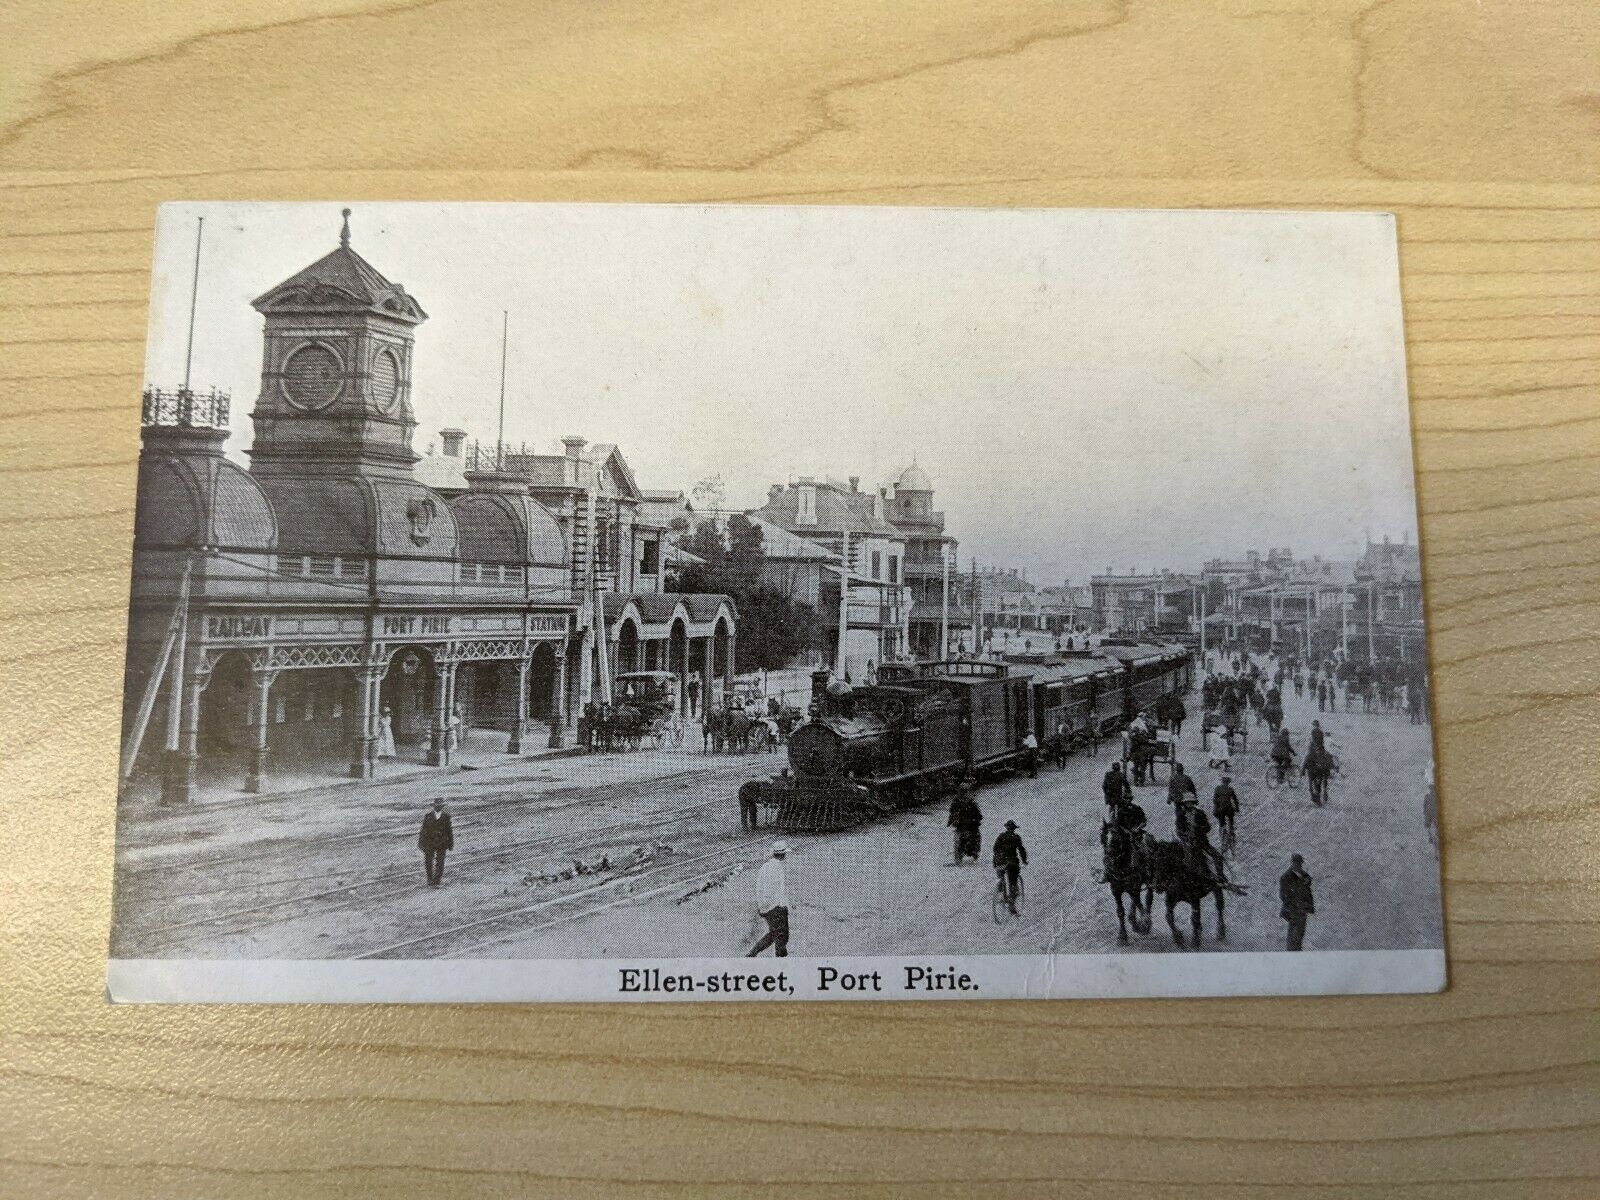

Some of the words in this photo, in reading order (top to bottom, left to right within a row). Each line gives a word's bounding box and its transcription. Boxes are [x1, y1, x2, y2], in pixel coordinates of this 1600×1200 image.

[383, 616, 415, 635] PORT
[530, 615, 566, 632] STATION
[618, 968, 796, 995] Ellen-street,
[816, 966, 882, 992] Port
[903, 966, 980, 992] Pirie.
